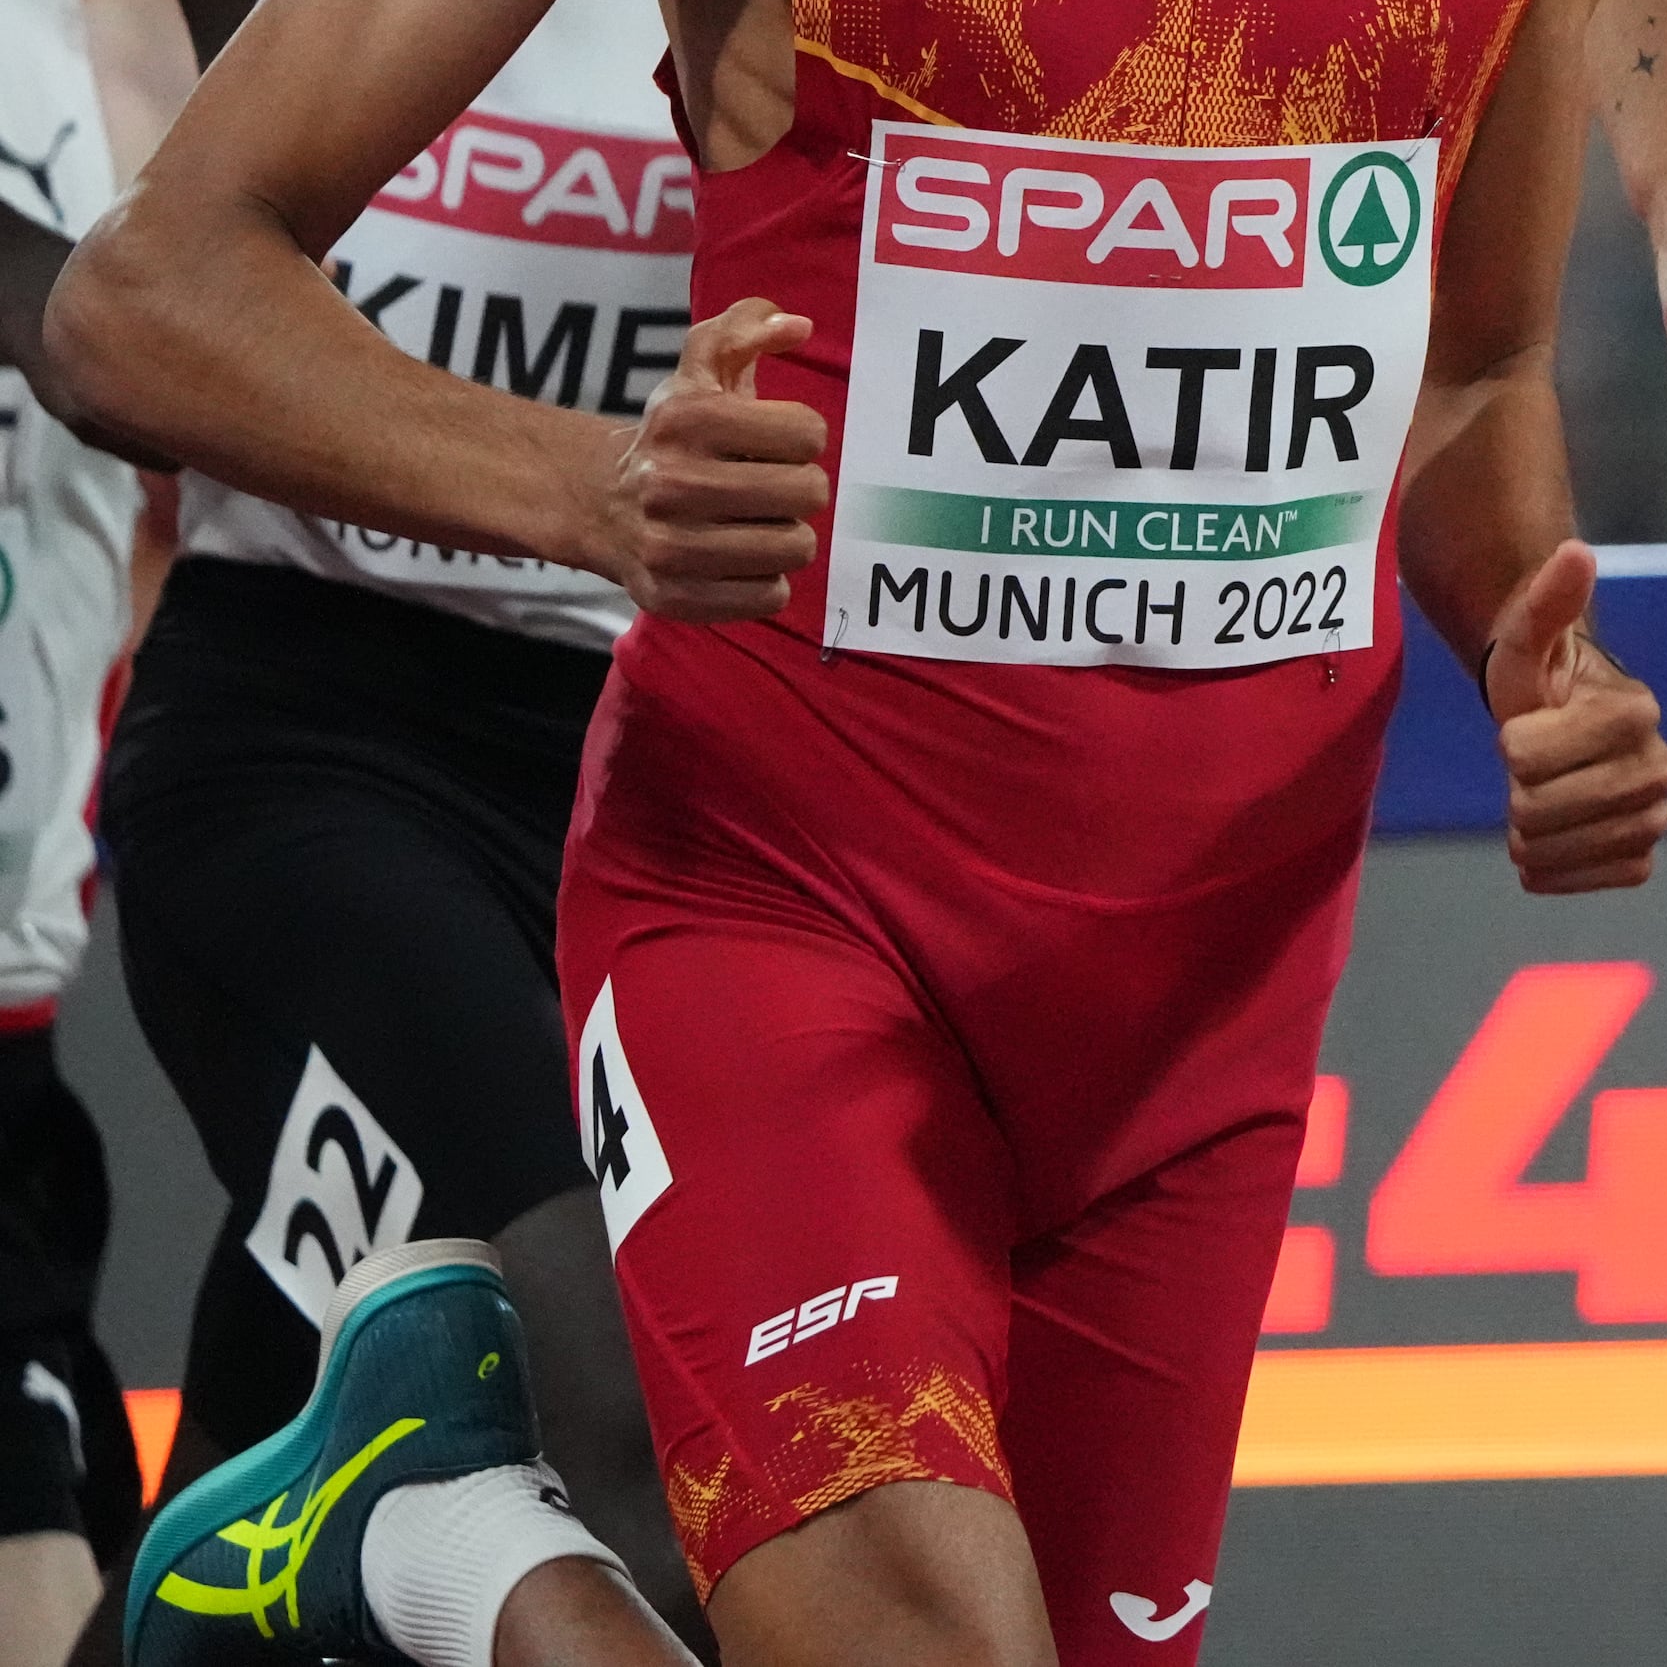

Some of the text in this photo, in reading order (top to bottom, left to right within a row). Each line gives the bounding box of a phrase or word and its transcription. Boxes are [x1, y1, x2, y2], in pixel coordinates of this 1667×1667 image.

[890, 155, 1295, 270] SPAR
[907, 328, 1376, 473] KATIR
[981, 505, 991, 544] I
[1012, 506, 1117, 551] RUN
[868, 562, 1348, 646] MUNICH 2022
[592, 1040, 632, 1193] 4
[744, 1275, 899, 1367] ESP
